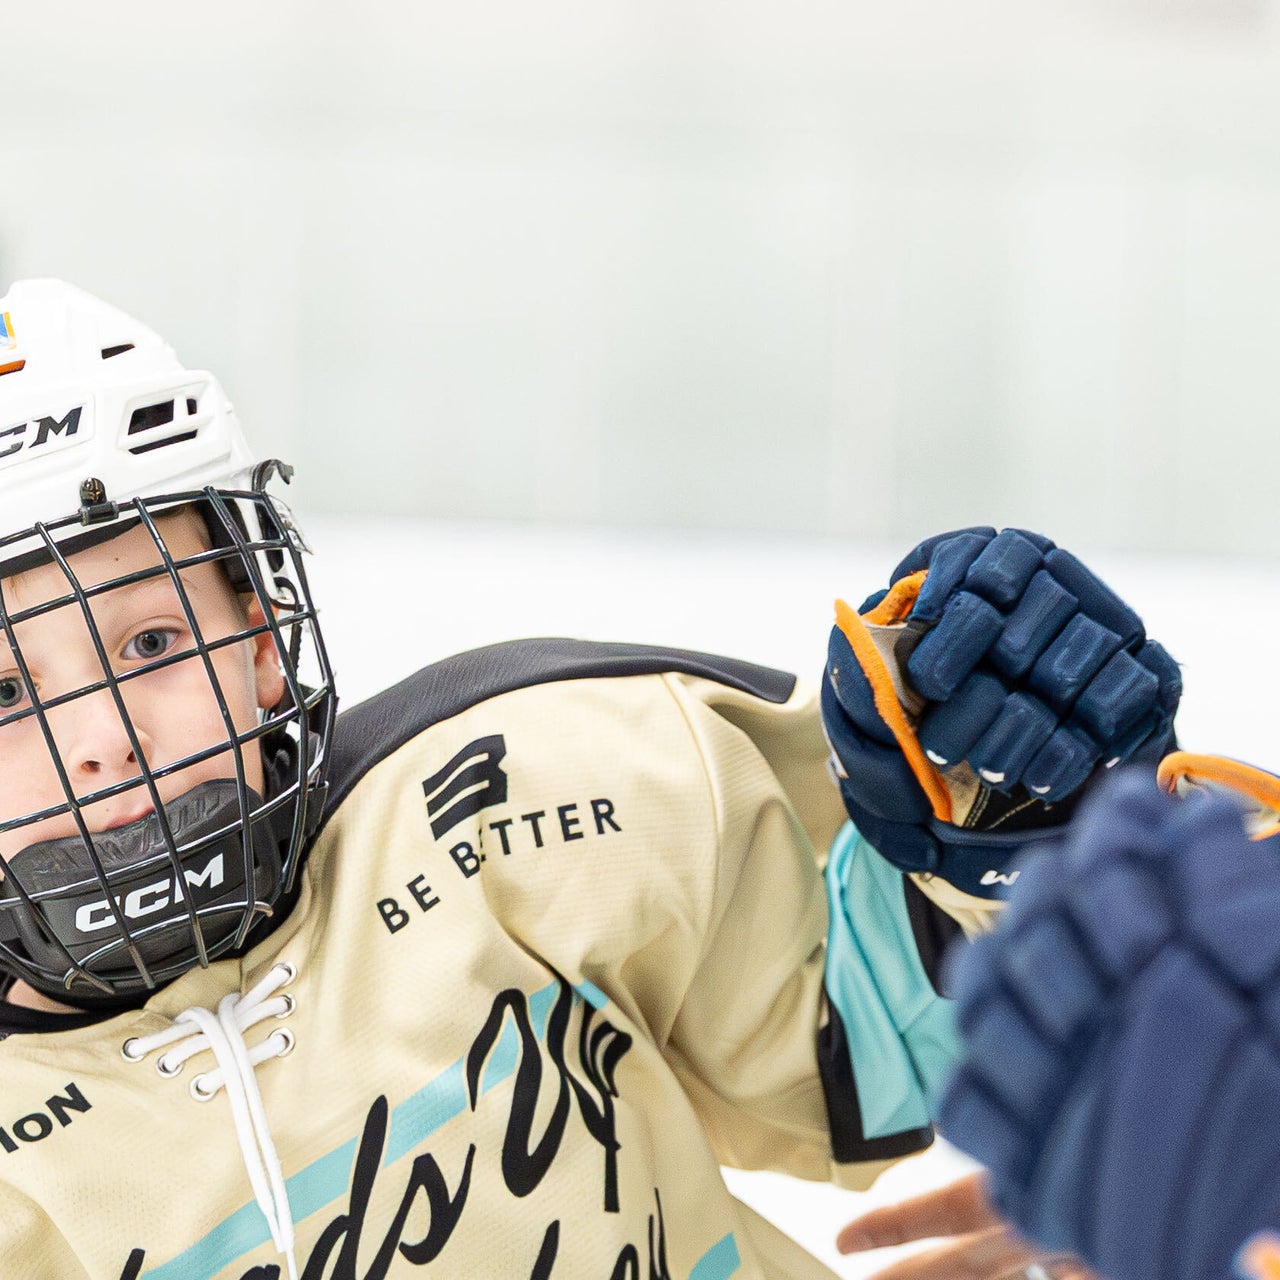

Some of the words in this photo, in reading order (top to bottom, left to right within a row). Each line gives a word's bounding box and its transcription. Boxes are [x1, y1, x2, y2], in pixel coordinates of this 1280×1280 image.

[75, 852, 225, 933] CCM
[376, 873, 441, 935] BE
[448, 797, 623, 879] BTTER
